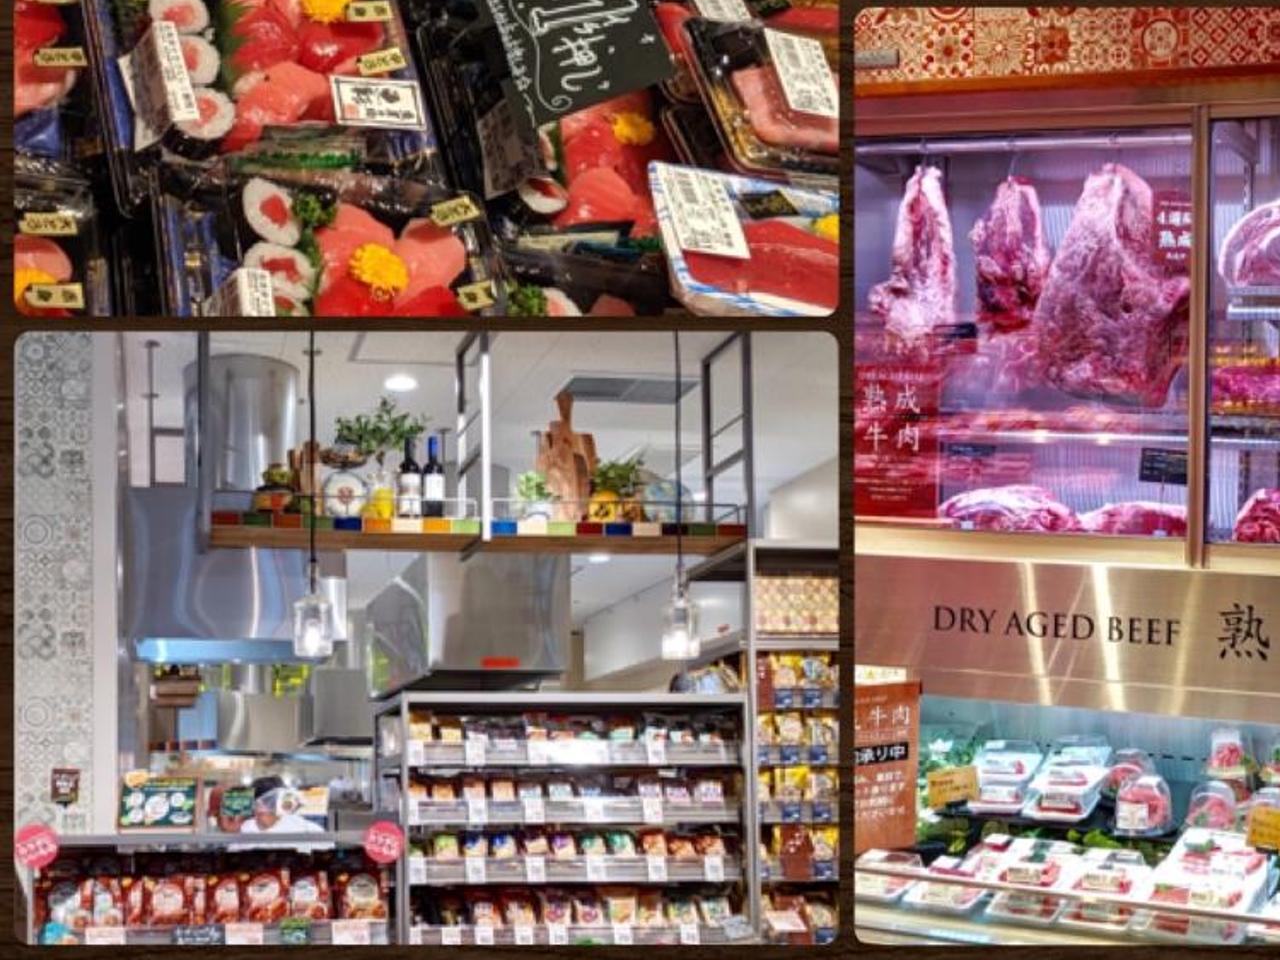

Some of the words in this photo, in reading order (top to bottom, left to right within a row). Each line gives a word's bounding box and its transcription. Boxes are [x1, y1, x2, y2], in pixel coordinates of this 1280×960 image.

[863, 422, 921, 452] 牛肉
[933, 605, 996, 633] DRY
[1004, 611, 1094, 641] AGED
[1107, 616, 1182, 646] BEEF
